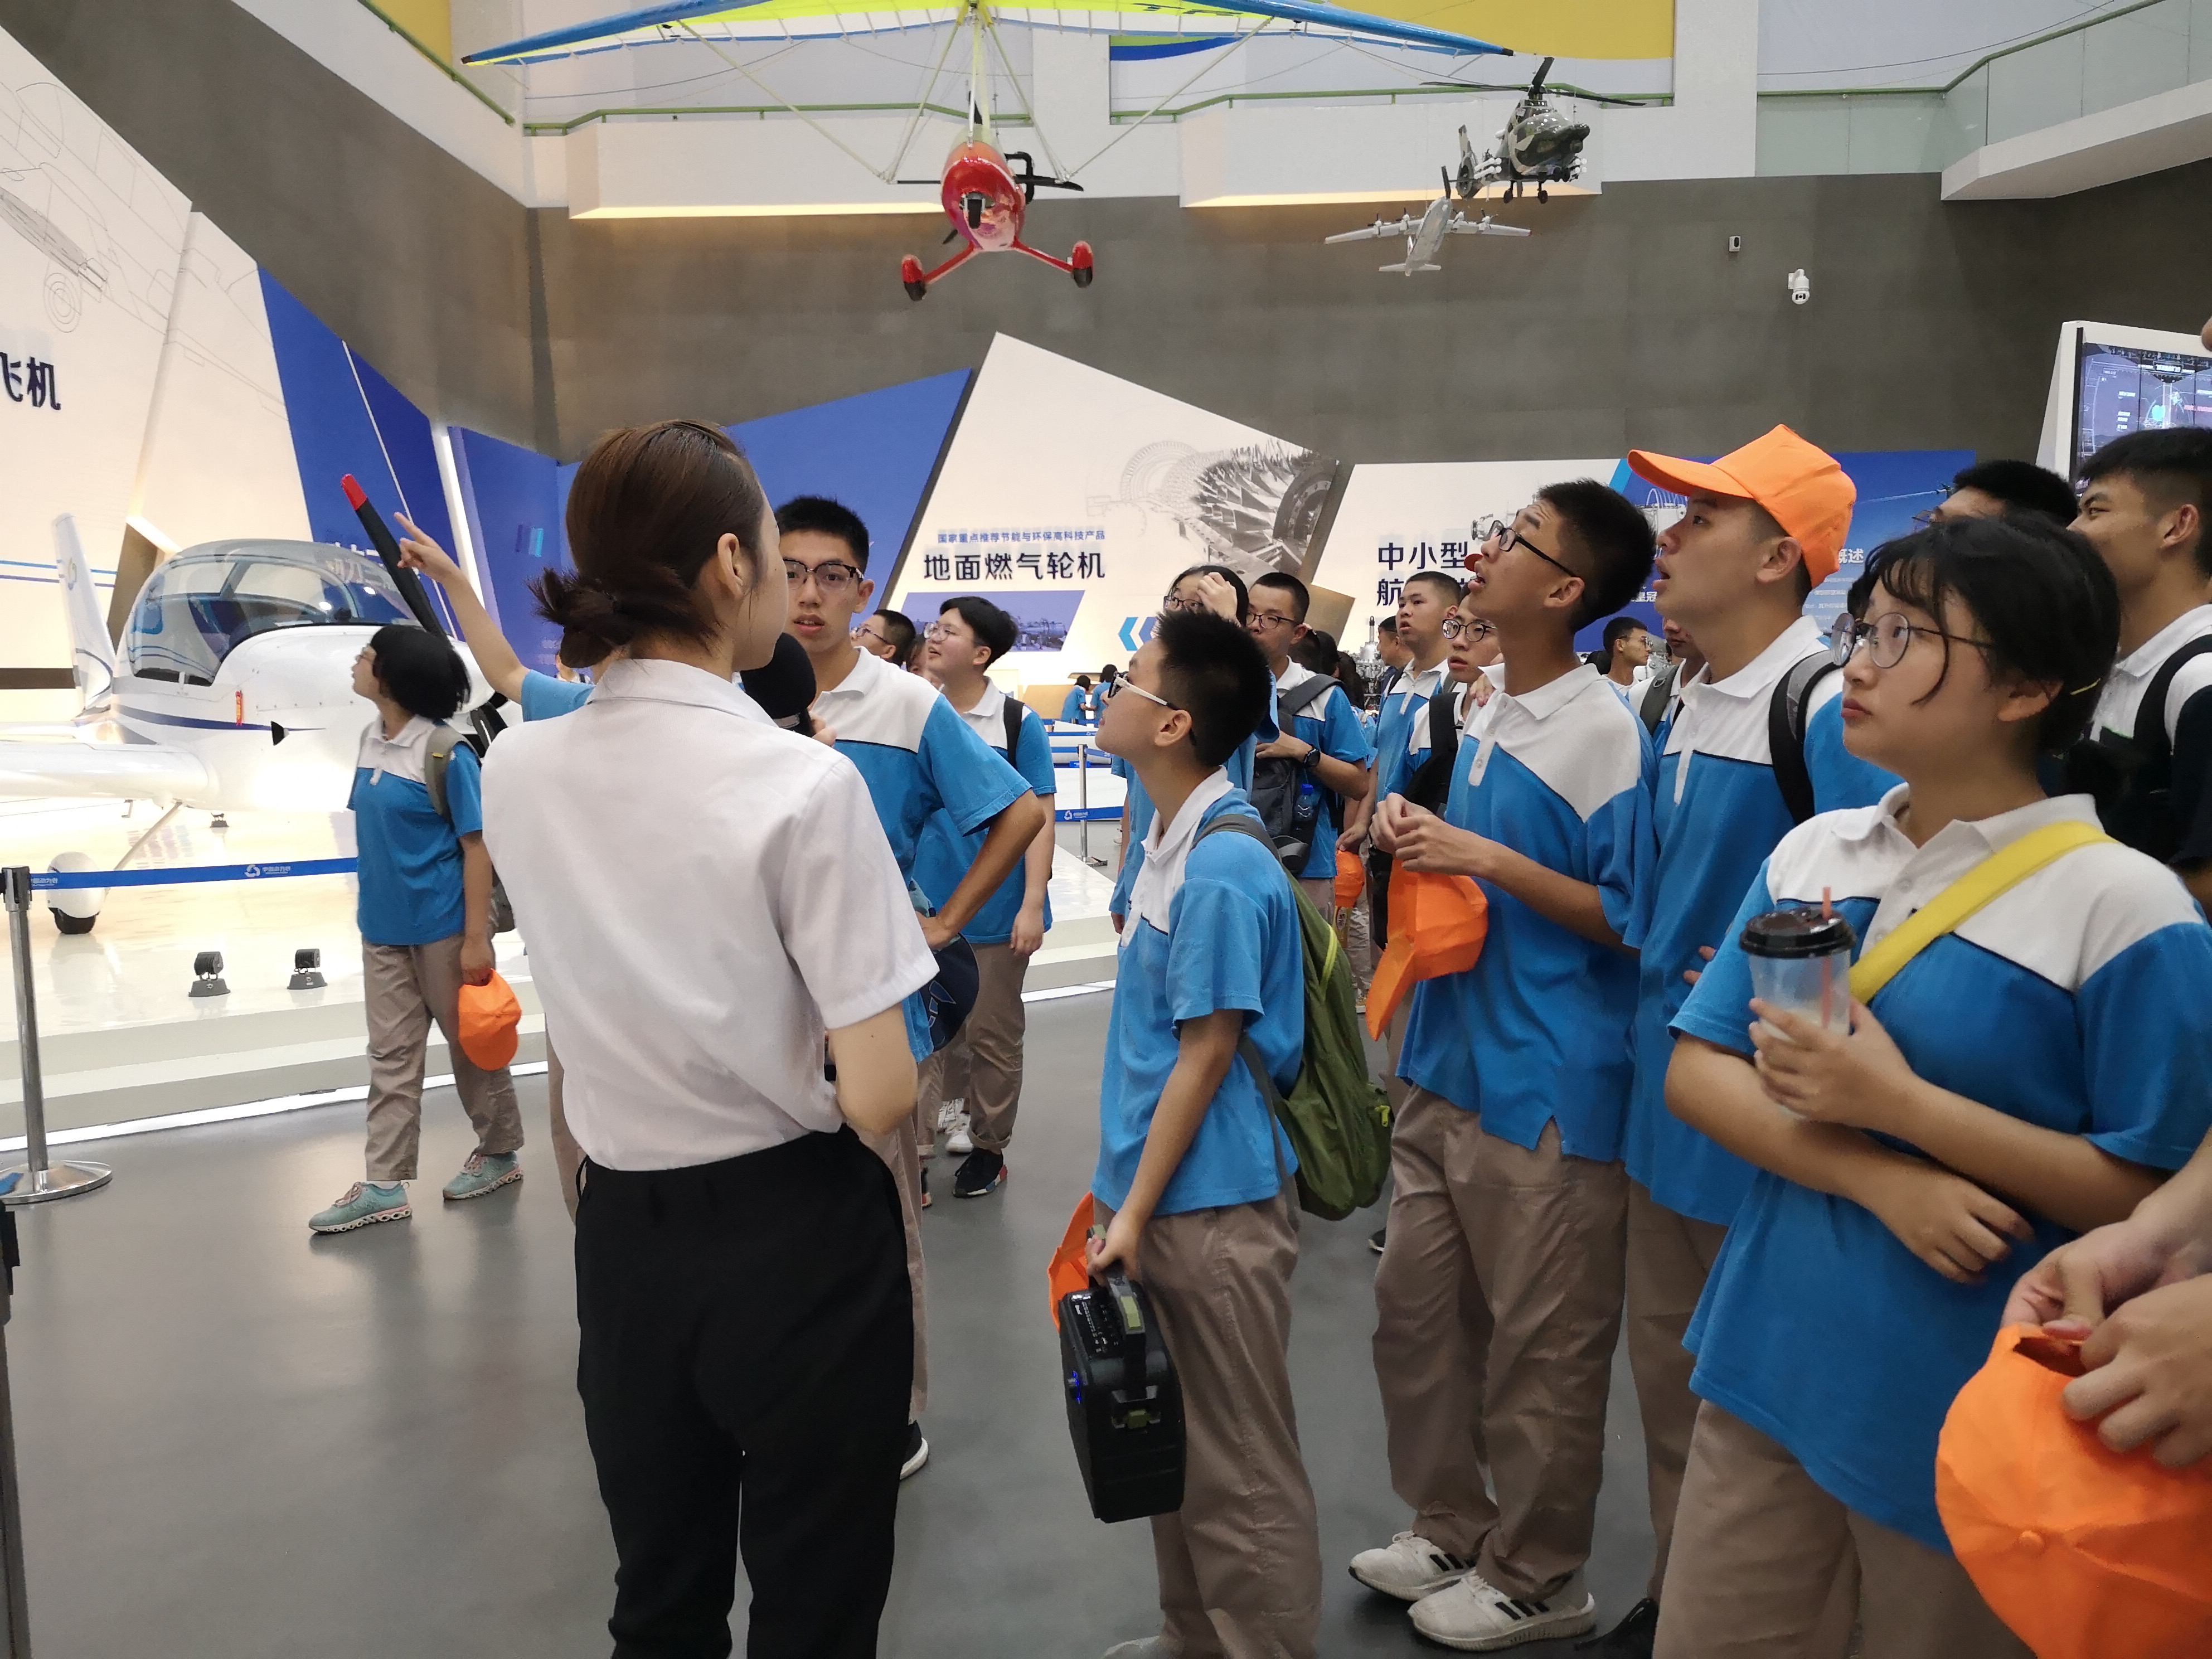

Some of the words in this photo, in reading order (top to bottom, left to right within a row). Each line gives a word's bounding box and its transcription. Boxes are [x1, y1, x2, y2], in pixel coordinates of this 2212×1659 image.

[0, 352, 61, 410] 飞机
[938, 530, 1105, 544] 国家重点推荐节能与环保高科技产品
[924, 551, 1105, 580] 地面燃气轮机
[1378, 541, 1468, 570] 中小型
